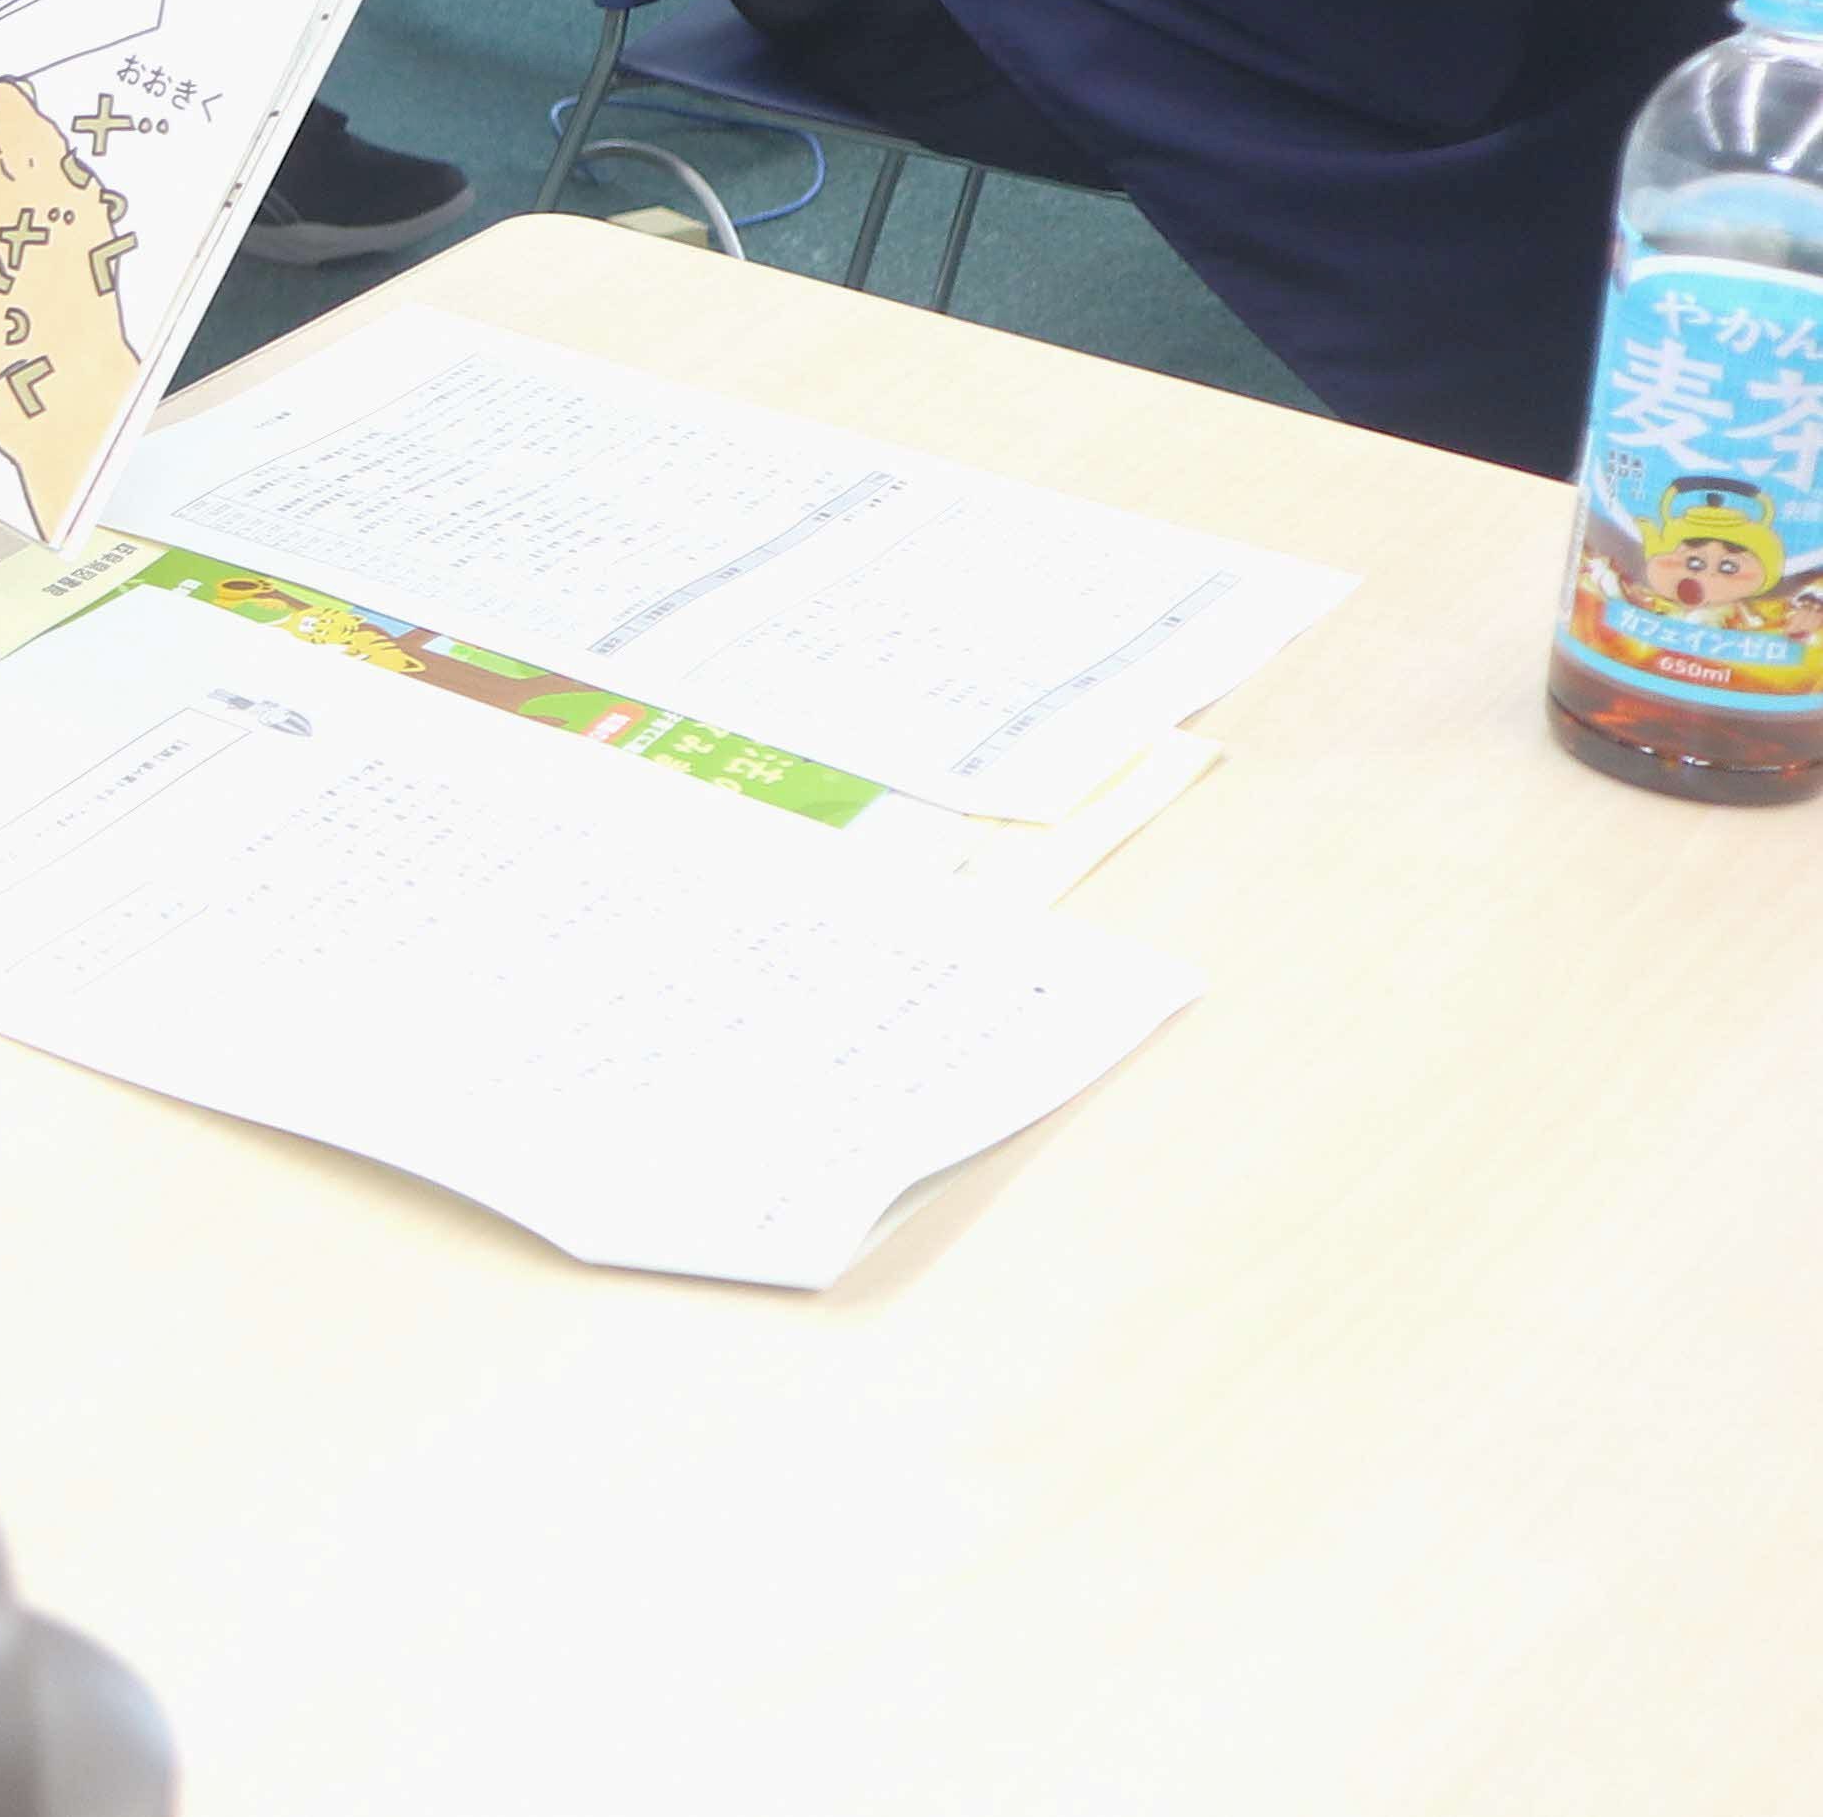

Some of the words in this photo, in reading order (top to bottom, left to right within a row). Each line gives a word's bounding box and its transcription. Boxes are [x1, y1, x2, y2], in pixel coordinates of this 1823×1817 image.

[116, 54, 224, 123] おおきく
[1655, 289, 1823, 363] やかん
[41, 542, 139, 597] 岐阜県図書館
[1617, 607, 1790, 661] カフェインゼロ
[1658, 654, 1732, 684] 650ml
